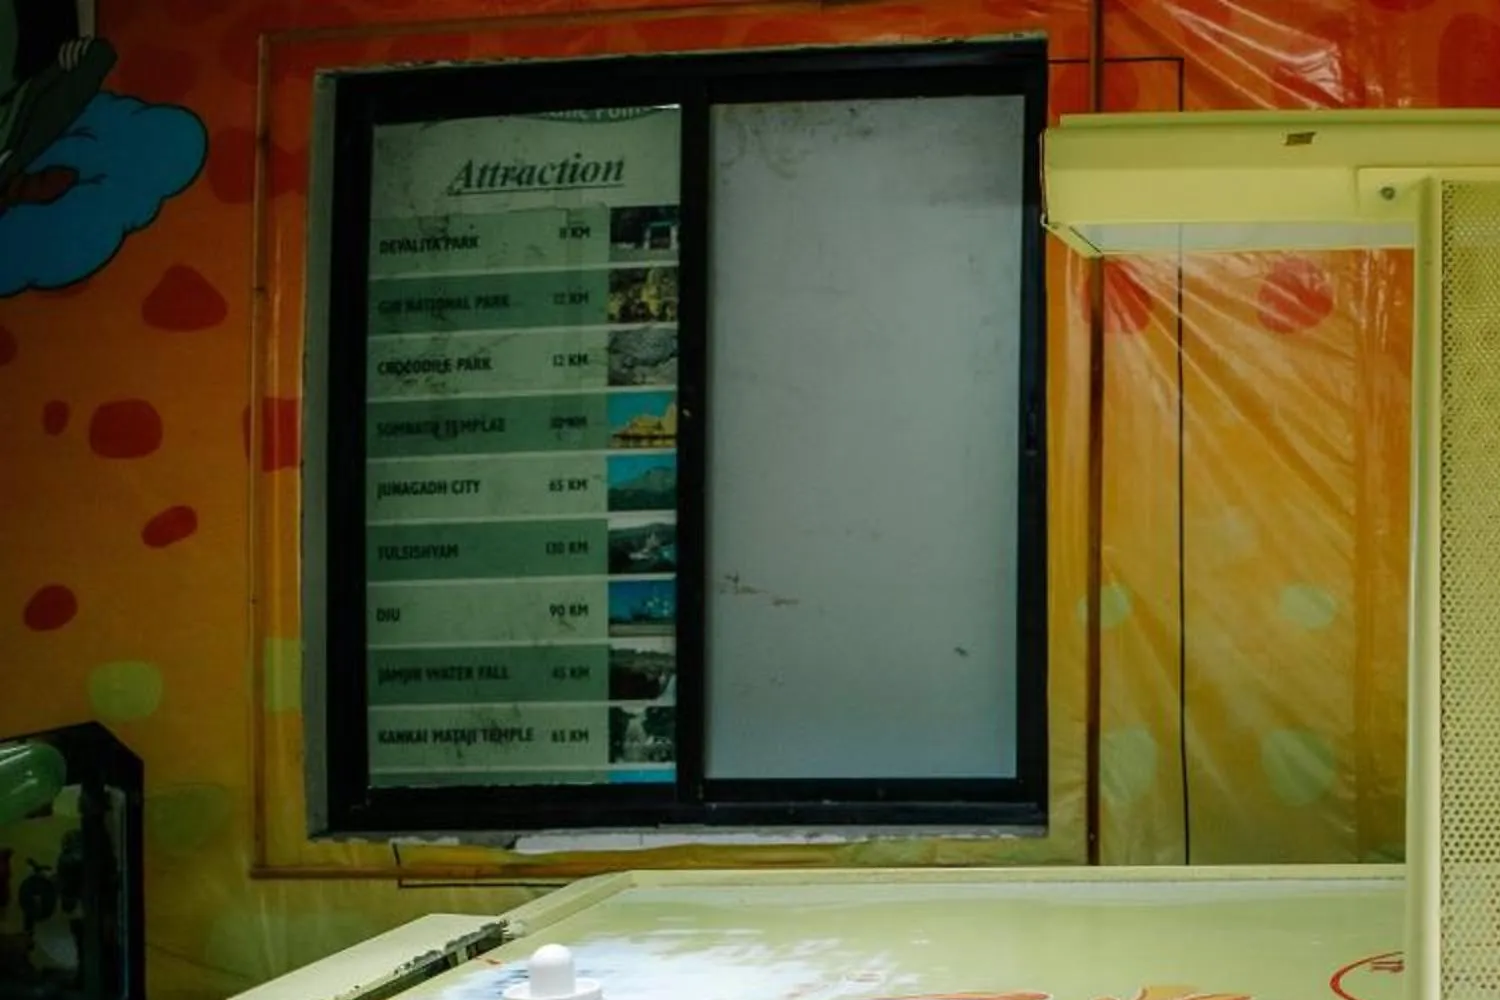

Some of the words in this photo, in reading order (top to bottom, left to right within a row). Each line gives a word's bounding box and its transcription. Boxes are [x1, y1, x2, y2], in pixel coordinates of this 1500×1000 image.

[450, 153, 625, 191] Attraction
[570, 225, 591, 240] KM
[444, 234, 480, 251] PARK
[405, 295, 471, 312] NATIONAL
[474, 293, 511, 310] PARK
[570, 290, 590, 305] KM
[377, 358, 453, 376] CROCODILE
[456, 356, 494, 372] PARK
[552, 353, 566, 368] 12
[568, 352, 590, 367] KM
[377, 480, 448, 499] JUNAGADH
[451, 479, 481, 495] CITY
[549, 479, 564, 493] 65
[568, 478, 589, 492] KM
[377, 544, 459, 562] TULSISHYAM
[568, 540, 589, 555] KM
[376, 607, 401, 623] DIU
[549, 603, 566, 618] 90
[569, 602, 589, 617] KM
[425, 665, 474, 682] WATER
[477, 663, 511, 681] FALL
[569, 664, 591, 681] KM
[431, 727, 477, 746] MATAJI
[480, 726, 535, 744] TEMPLE
[569, 728, 590, 743] KM
